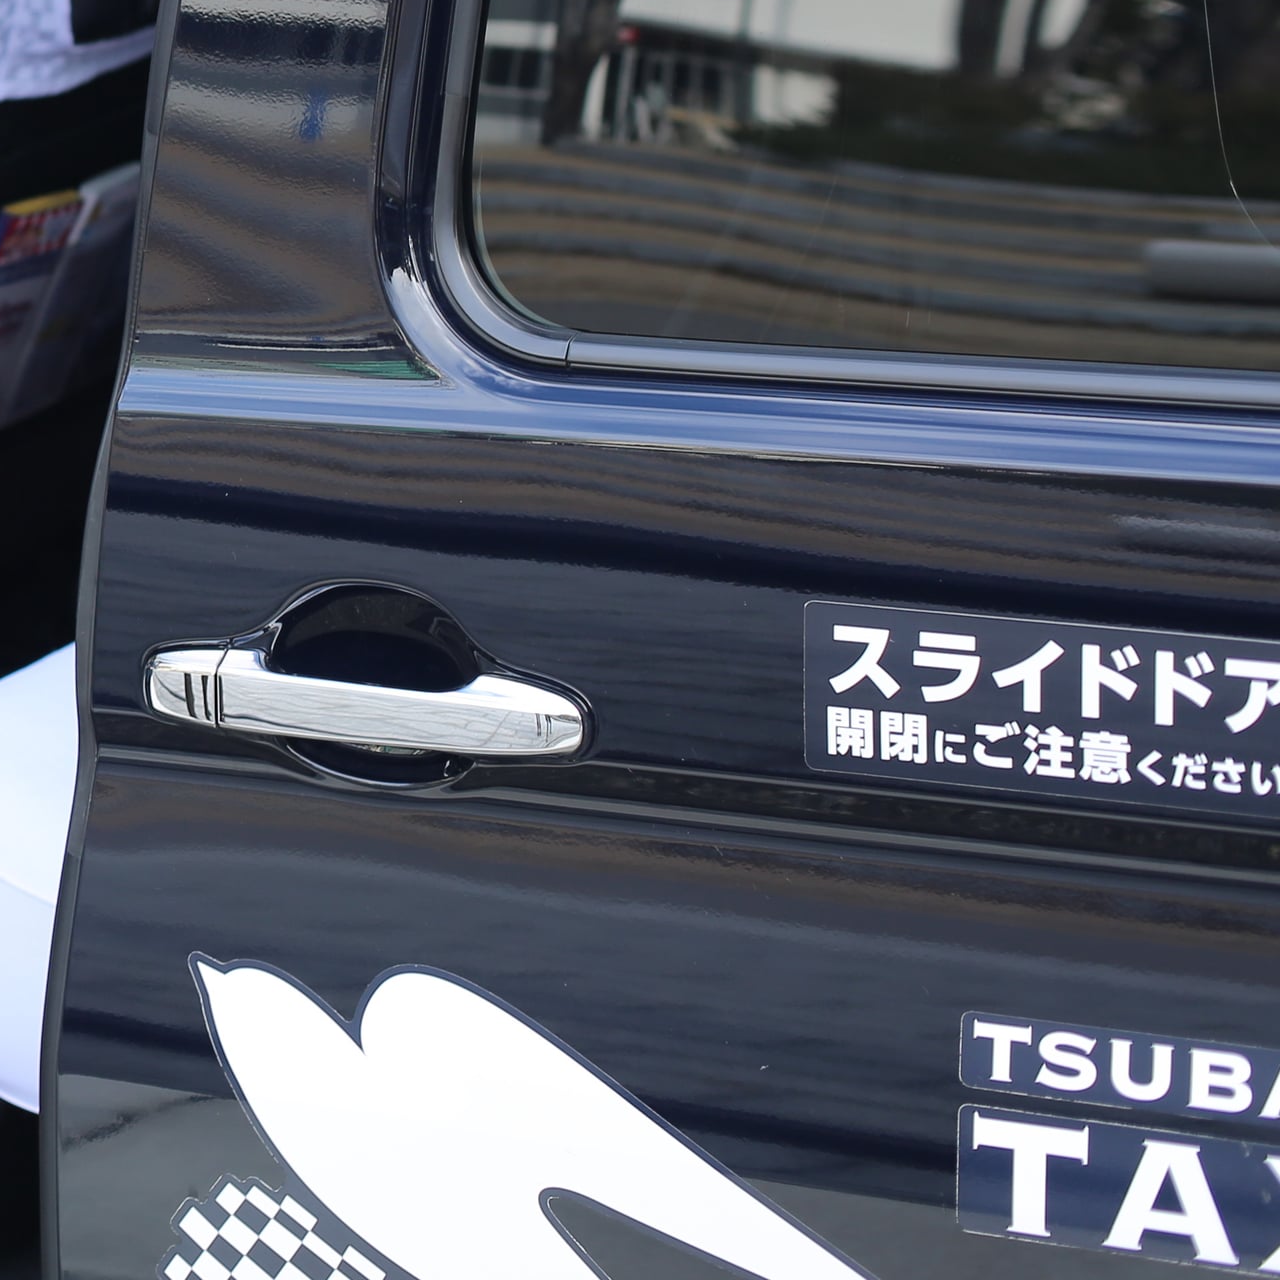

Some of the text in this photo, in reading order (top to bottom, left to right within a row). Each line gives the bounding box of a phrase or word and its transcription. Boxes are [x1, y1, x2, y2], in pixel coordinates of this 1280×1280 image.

[828, 624, 1280, 734] スライドドア
[826, 705, 1280, 797] 開閉にご注意ください
[972, 1018, 1280, 1120] TSUB
[972, 1110, 1280, 1274] TA
